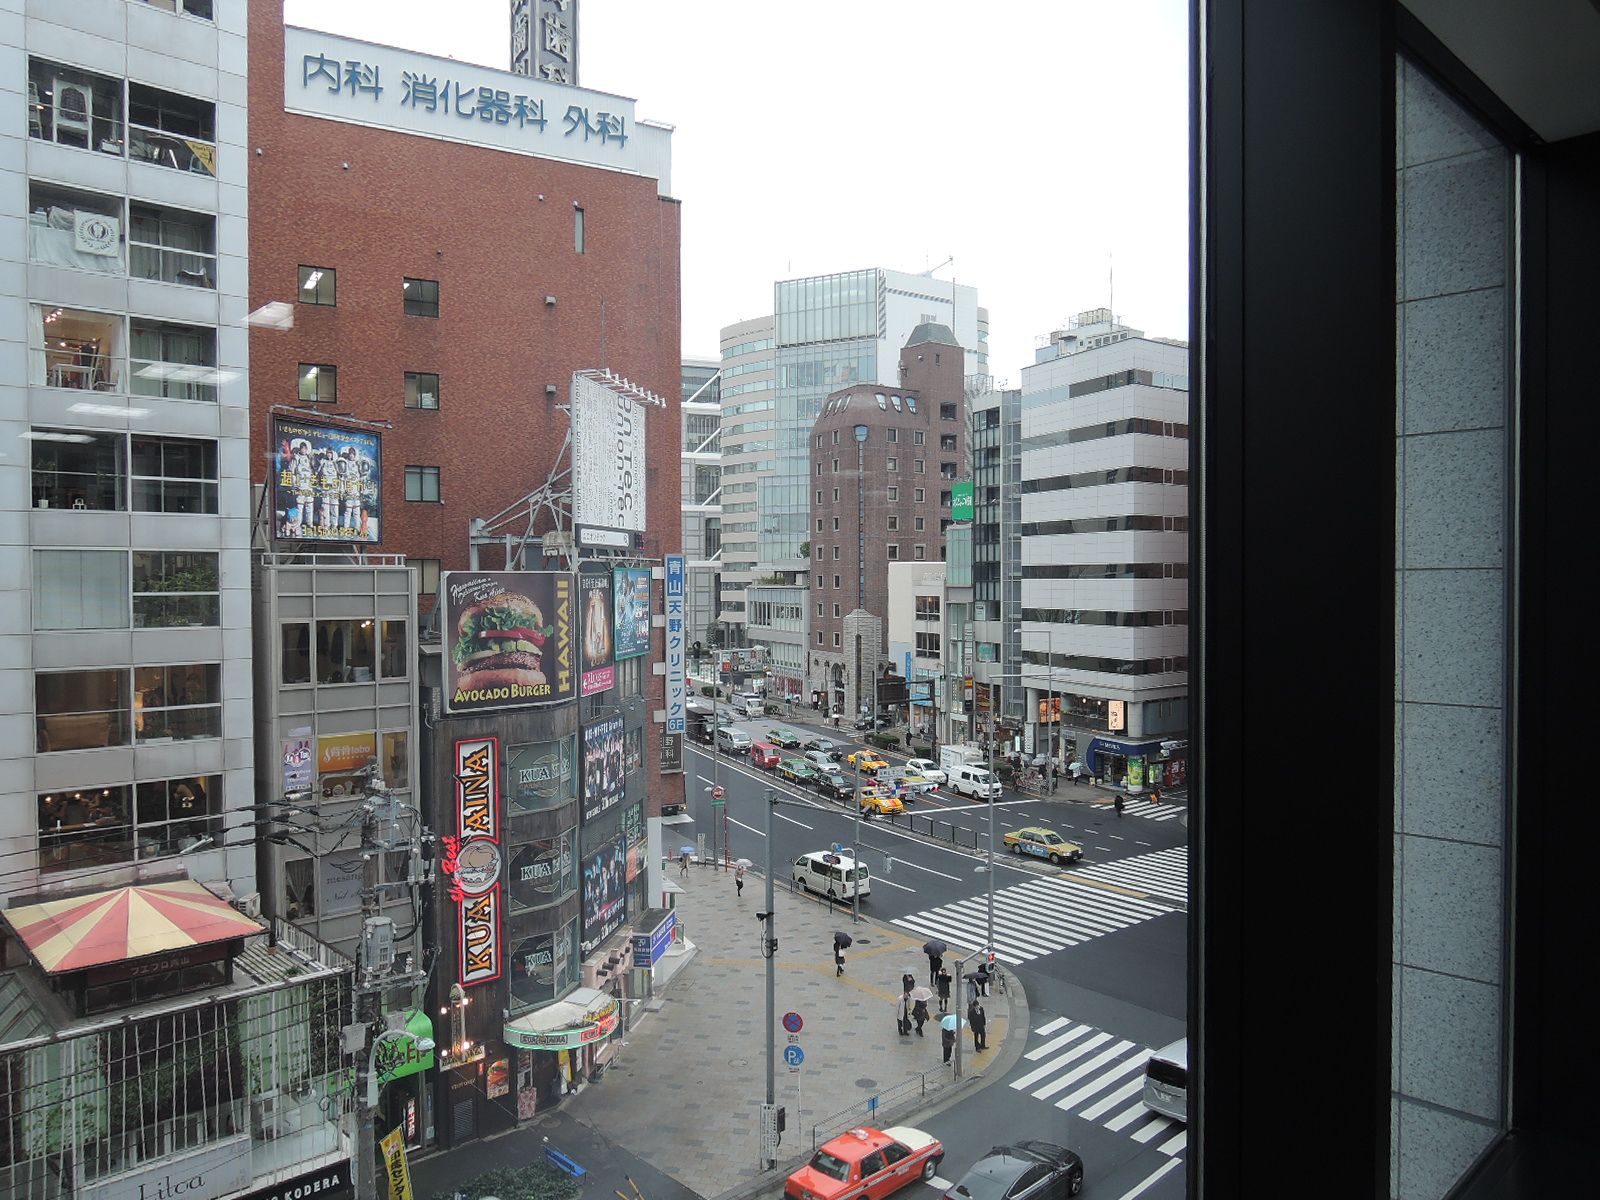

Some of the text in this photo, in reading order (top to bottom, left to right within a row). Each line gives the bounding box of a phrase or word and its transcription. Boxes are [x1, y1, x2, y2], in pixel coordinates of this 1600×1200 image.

[303, 53, 628, 149] 内科 消化器科 外科
[557, 580, 570, 692] HAWAII
[454, 684, 551, 703] AVOCADO BURGER
[668, 719, 684, 731] 6F
[520, 766, 551, 784] KUA
[441, 835, 458, 874] Best
[462, 744, 492, 976] KUA AINA
[520, 862, 552, 881] KUA
[524, 950, 553, 967] KUA
[284, 1174, 340, 1200] KODERA
